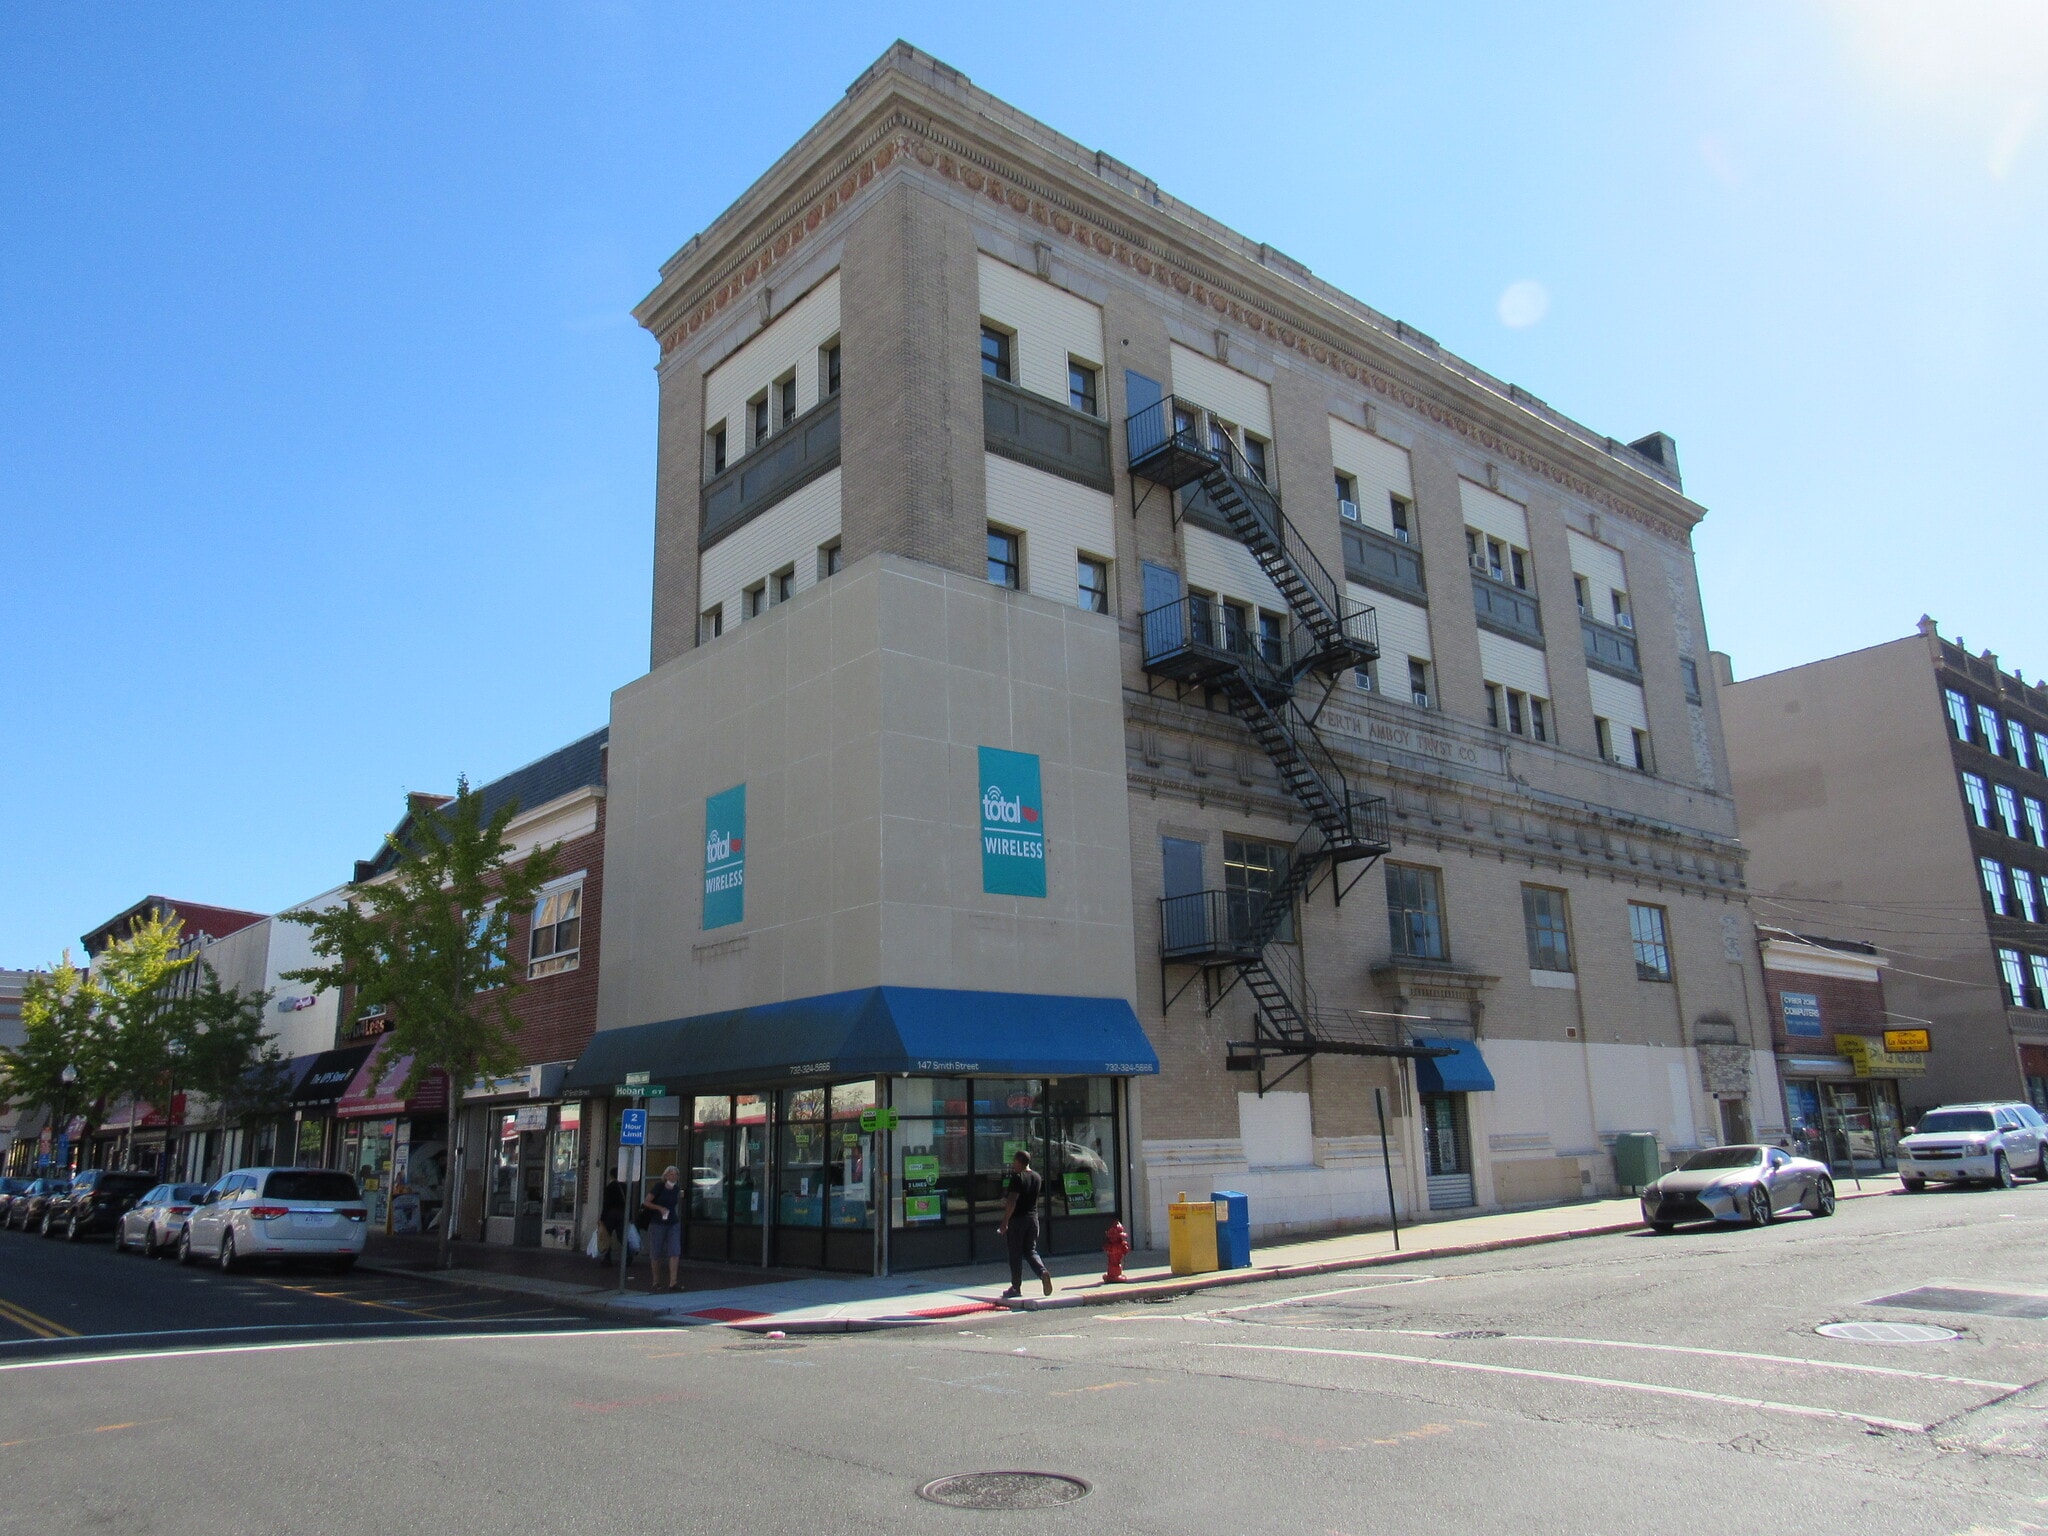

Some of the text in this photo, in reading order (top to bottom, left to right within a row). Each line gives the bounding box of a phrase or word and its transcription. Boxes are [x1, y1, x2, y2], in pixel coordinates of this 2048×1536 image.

[1320, 710, 1361, 733] PERTH
[1369, 723, 1409, 746] AMBOY
[1459, 746, 1478, 764] CO.
[983, 794, 1020, 823] total
[707, 831, 730, 863] total
[984, 837, 1043, 859] WIRELESS
[705, 869, 744, 894] WIRELESS
[917, 1061, 980, 1071] 147 Smith Street
[616, 1087, 645, 1095] Hobart
[631, 1113, 638, 1122] 2
